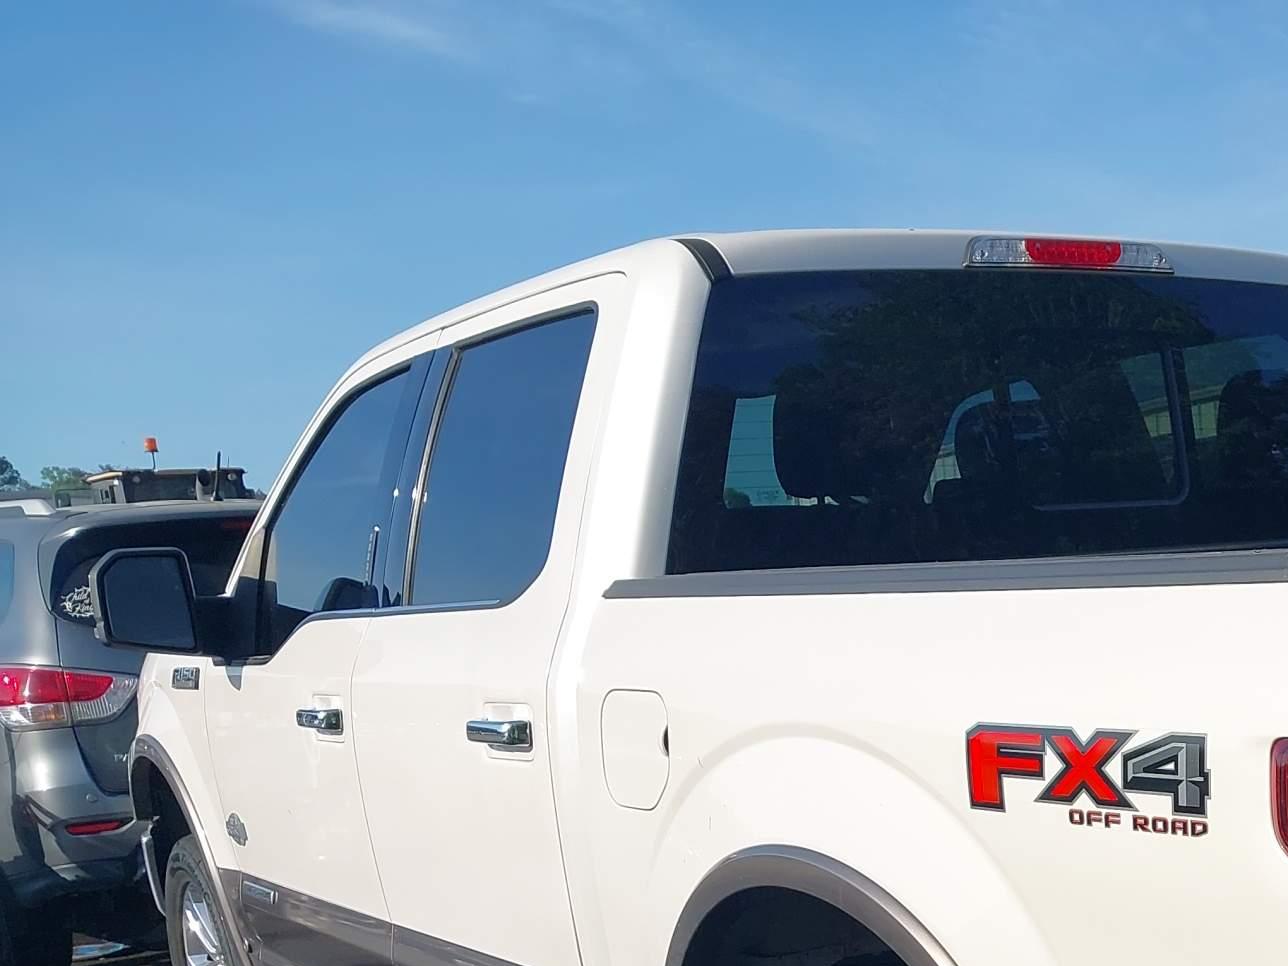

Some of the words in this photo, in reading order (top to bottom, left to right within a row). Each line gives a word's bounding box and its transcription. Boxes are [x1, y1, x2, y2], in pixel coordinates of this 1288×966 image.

[966, 722, 1211, 819] FX4
[1068, 808, 1122, 829] OFF
[1132, 814, 1209, 838] ROAD
